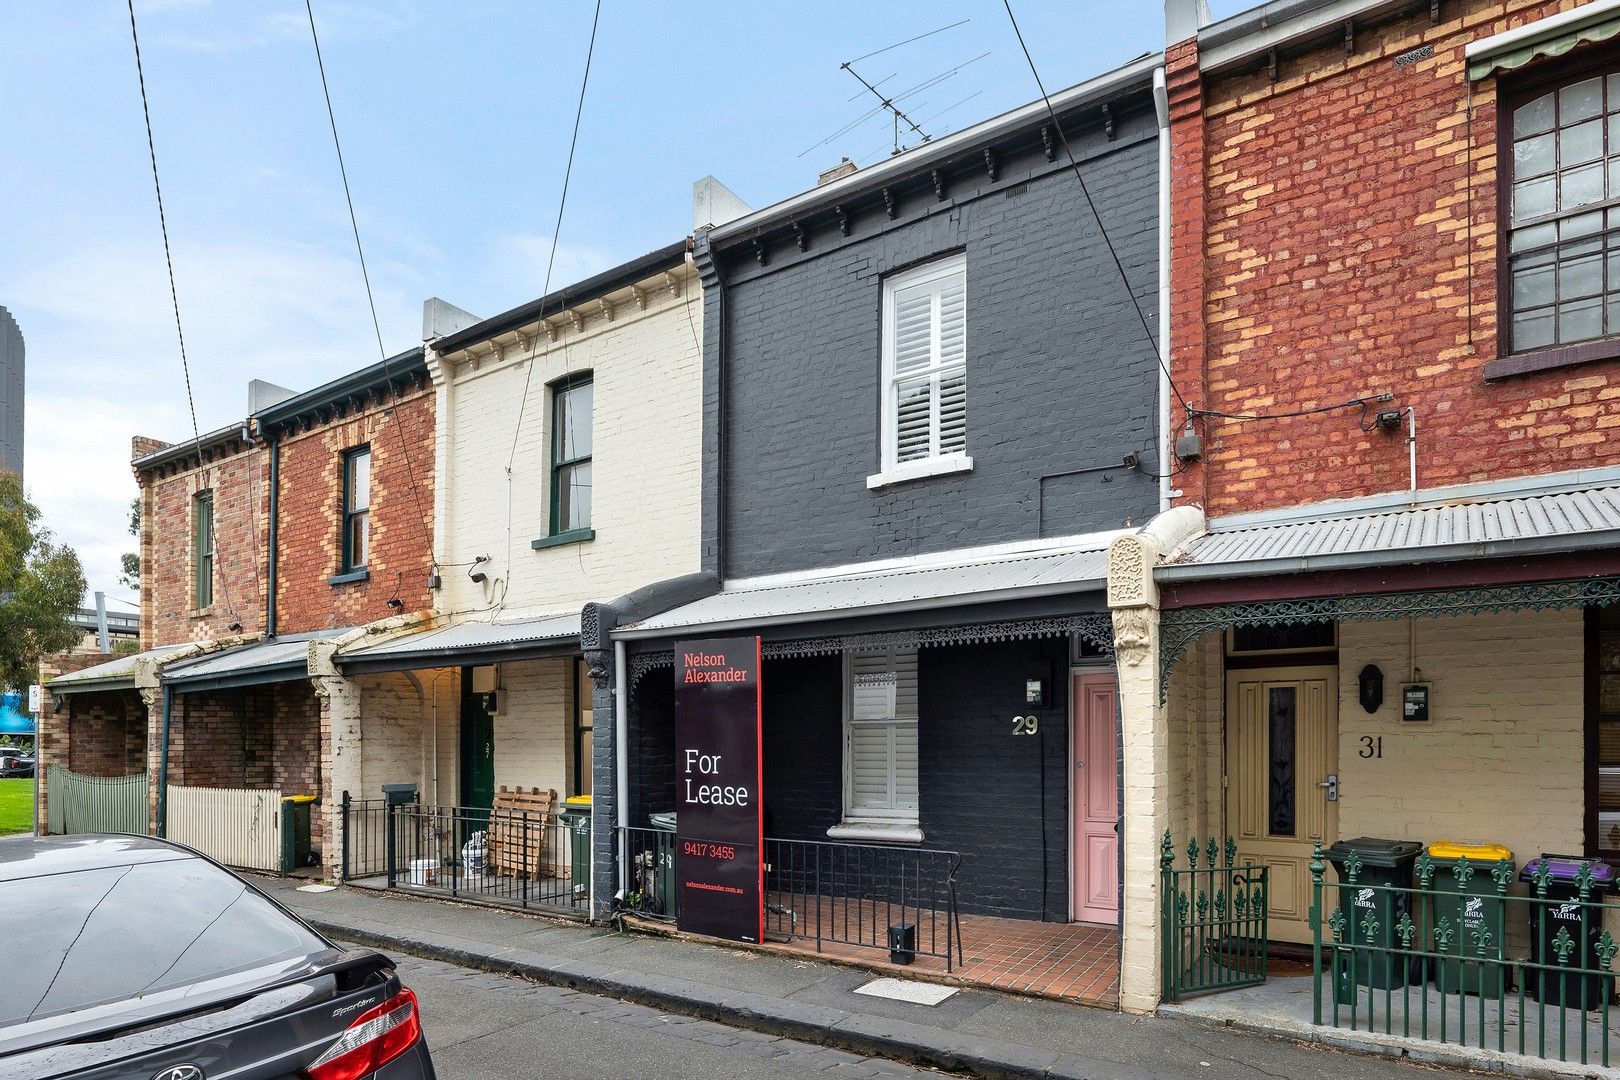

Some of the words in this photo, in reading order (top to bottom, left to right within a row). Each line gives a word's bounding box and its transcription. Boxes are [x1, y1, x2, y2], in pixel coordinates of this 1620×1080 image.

[684, 652, 726, 667] Nelson
[684, 667, 747, 683] Alexander
[1012, 715, 1038, 736] 29
[1359, 735, 1382, 759] 31
[685, 749, 721, 774] For
[685, 779, 748, 806] Lease
[684, 842, 707, 856] 9417
[709, 845, 735, 860] 3455
[660, 852, 672, 869] 29
[686, 881, 744, 895] nelsonalexander.com.au
